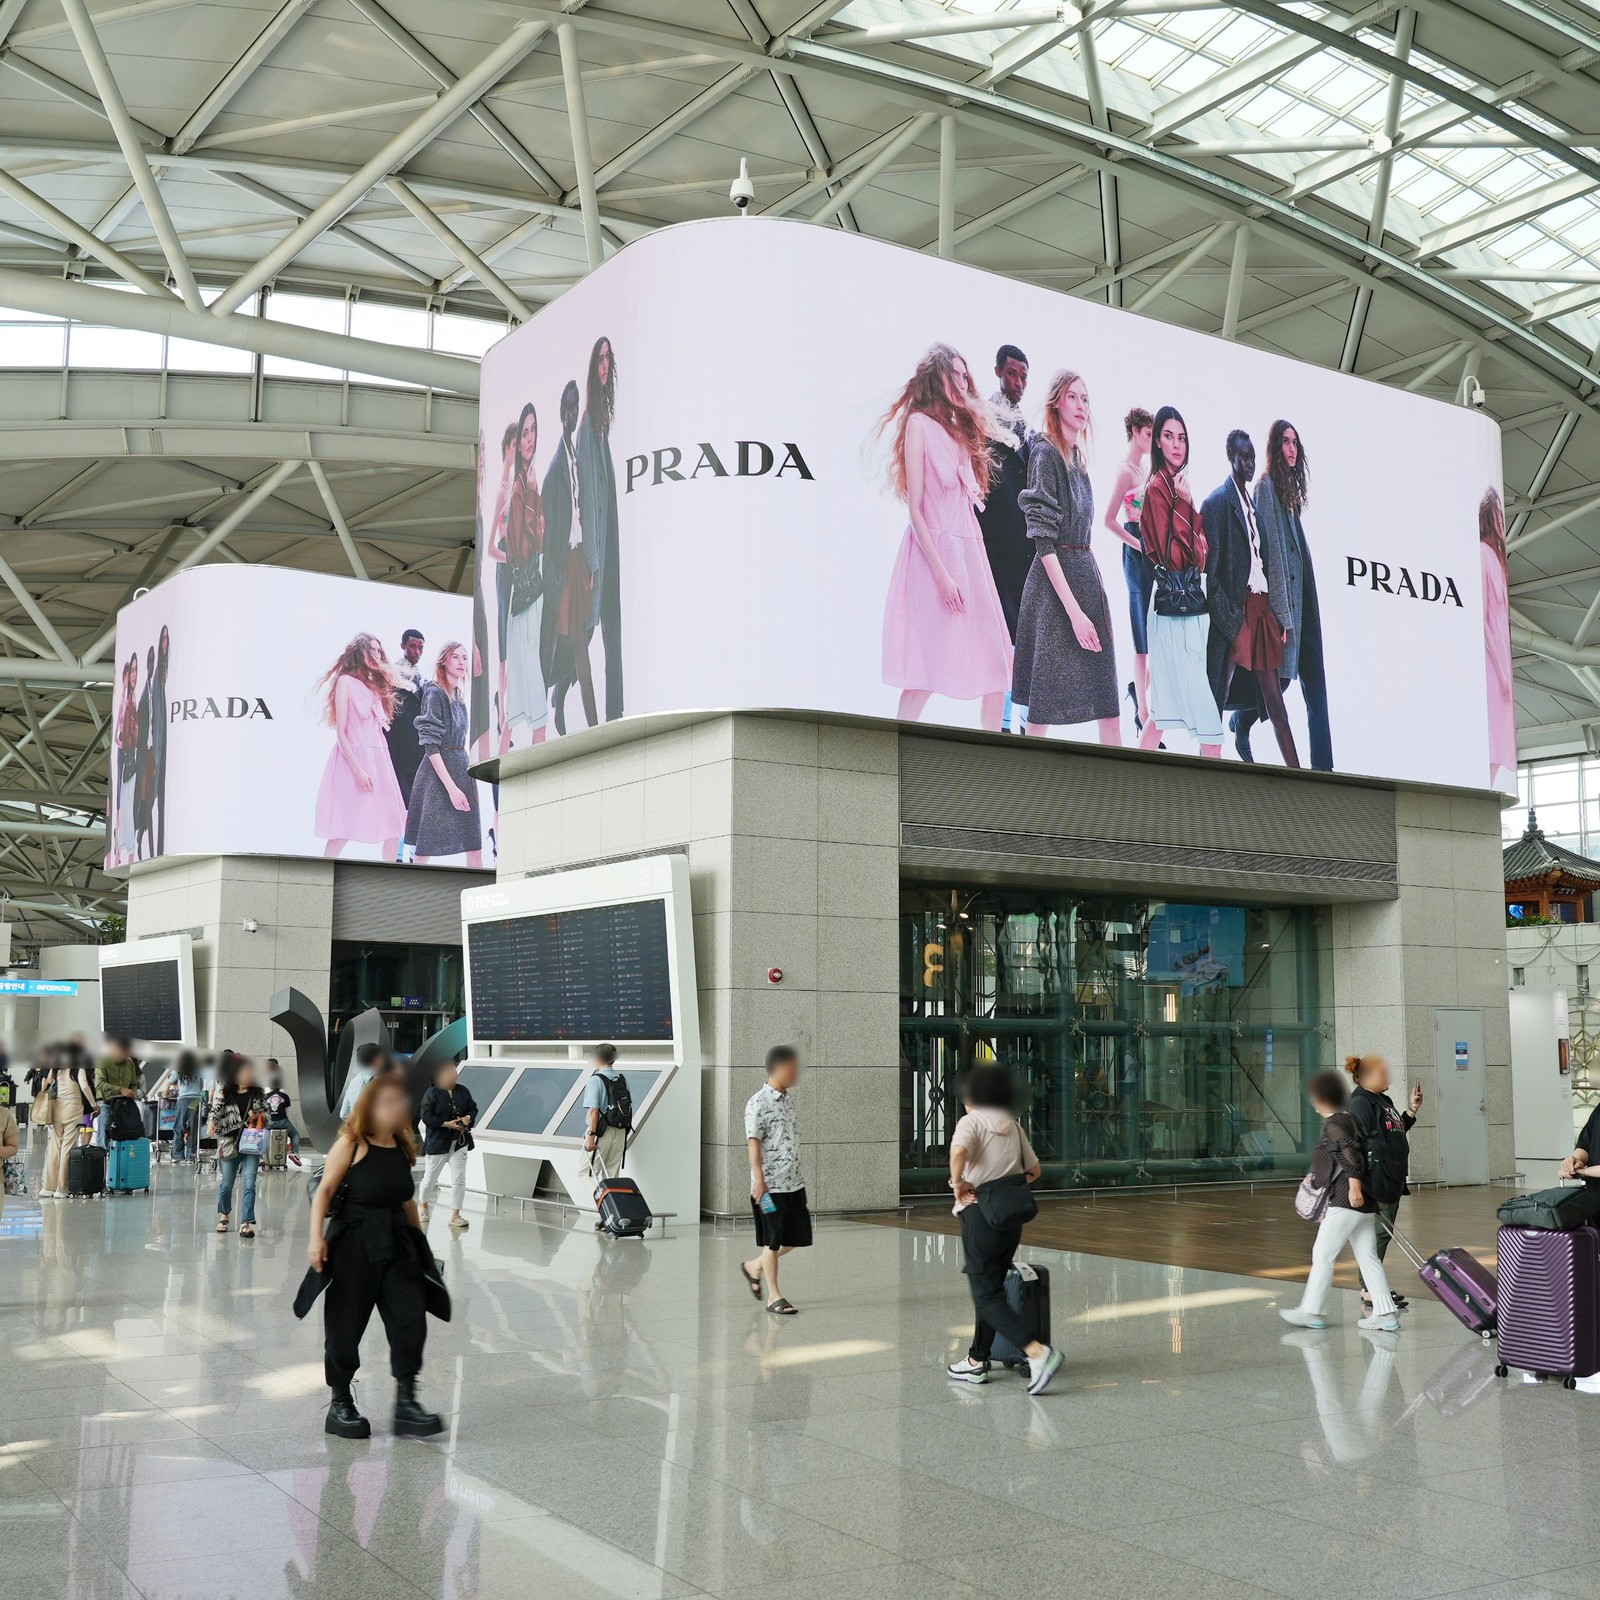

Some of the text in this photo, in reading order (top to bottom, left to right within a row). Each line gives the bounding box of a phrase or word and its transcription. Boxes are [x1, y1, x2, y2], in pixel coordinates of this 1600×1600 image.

[625, 440, 816, 495] PRADA
[1346, 556, 1464, 608] PRADA
[170, 697, 274, 723] PRADA
